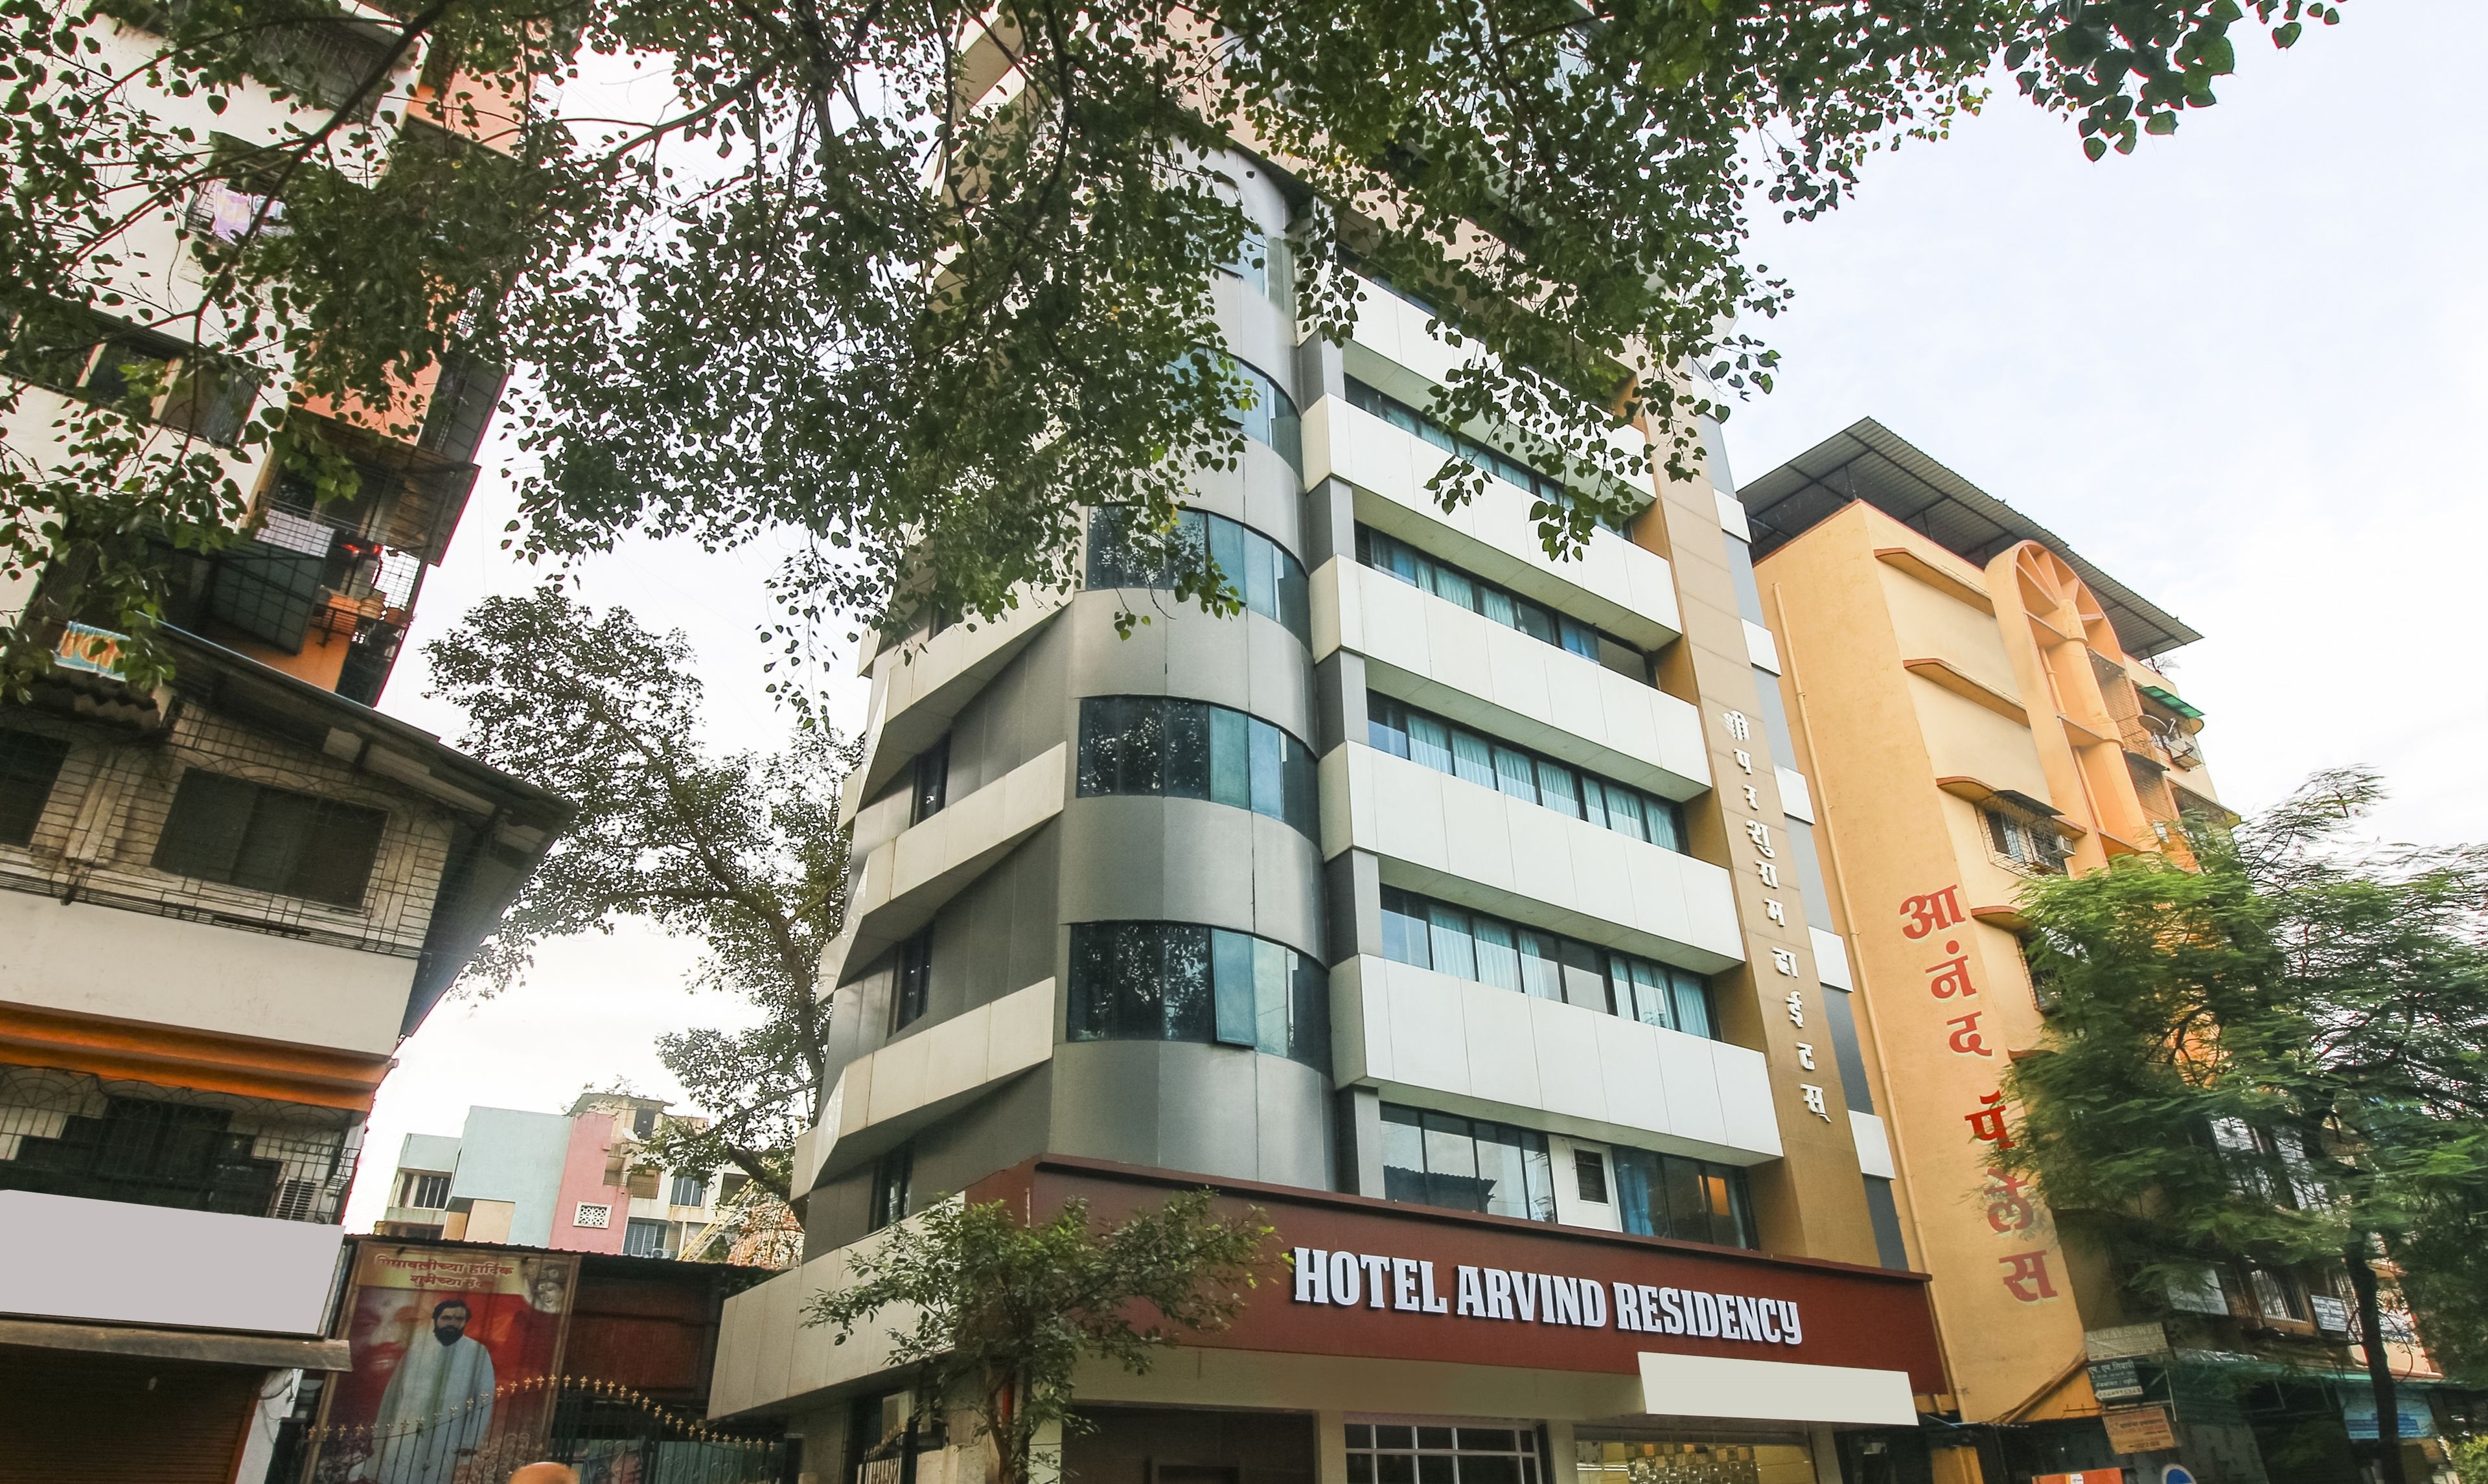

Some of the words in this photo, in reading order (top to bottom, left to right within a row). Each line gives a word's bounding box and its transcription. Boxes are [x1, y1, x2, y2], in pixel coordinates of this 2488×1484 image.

[1294, 1246, 1448, 1314] HOTEL
[1457, 1265, 1607, 1327] ARVIND
[1612, 1282, 1803, 1345] RESIDENCY
